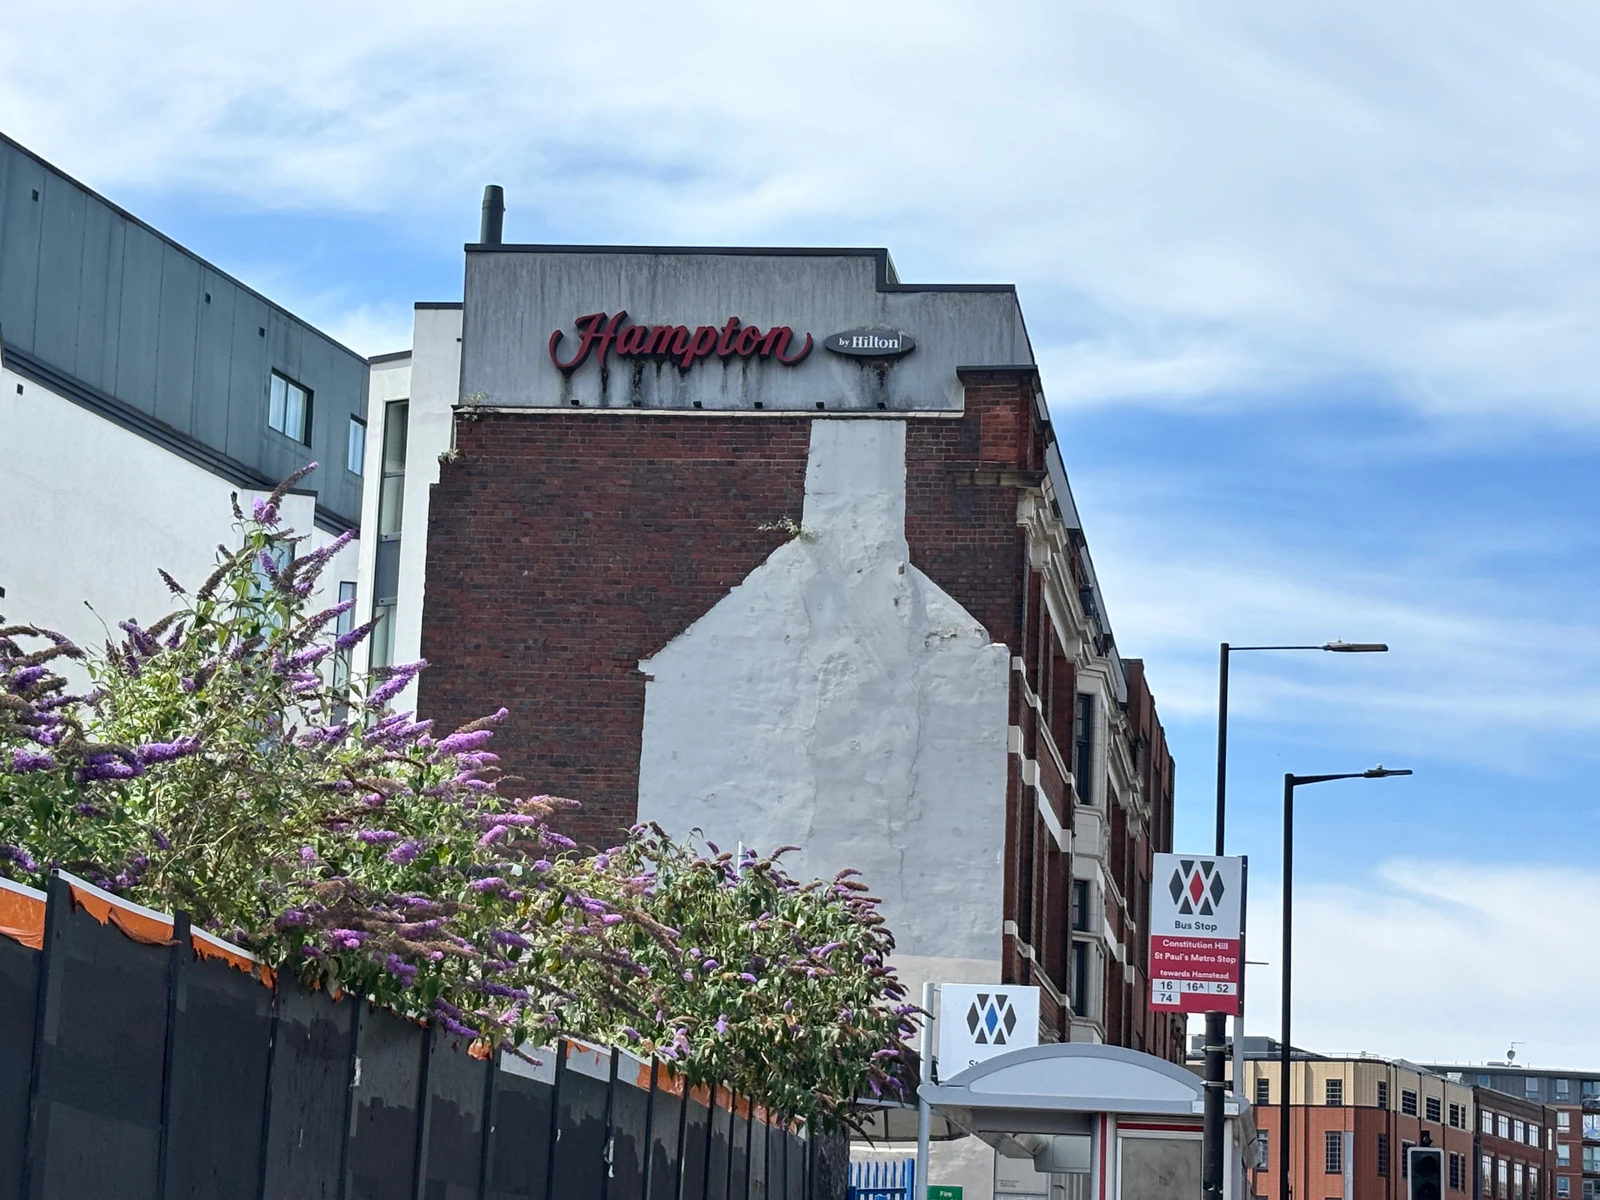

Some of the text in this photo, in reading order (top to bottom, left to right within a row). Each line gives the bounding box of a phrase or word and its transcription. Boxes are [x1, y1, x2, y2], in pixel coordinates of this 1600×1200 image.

[549, 310, 814, 369] Hampton
[839, 335, 899, 349] by Hilton
[1174, 920, 1218, 933] Bus Stop
[1162, 939, 1229, 950] Constitution Hill
[1154, 951, 1237, 965] St Paul's Metro Stop
[1160, 969, 1230, 980] towards Hamstead
[1160, 981, 1229, 993] 16 16A 52
[1160, 993, 1173, 1002] 74
